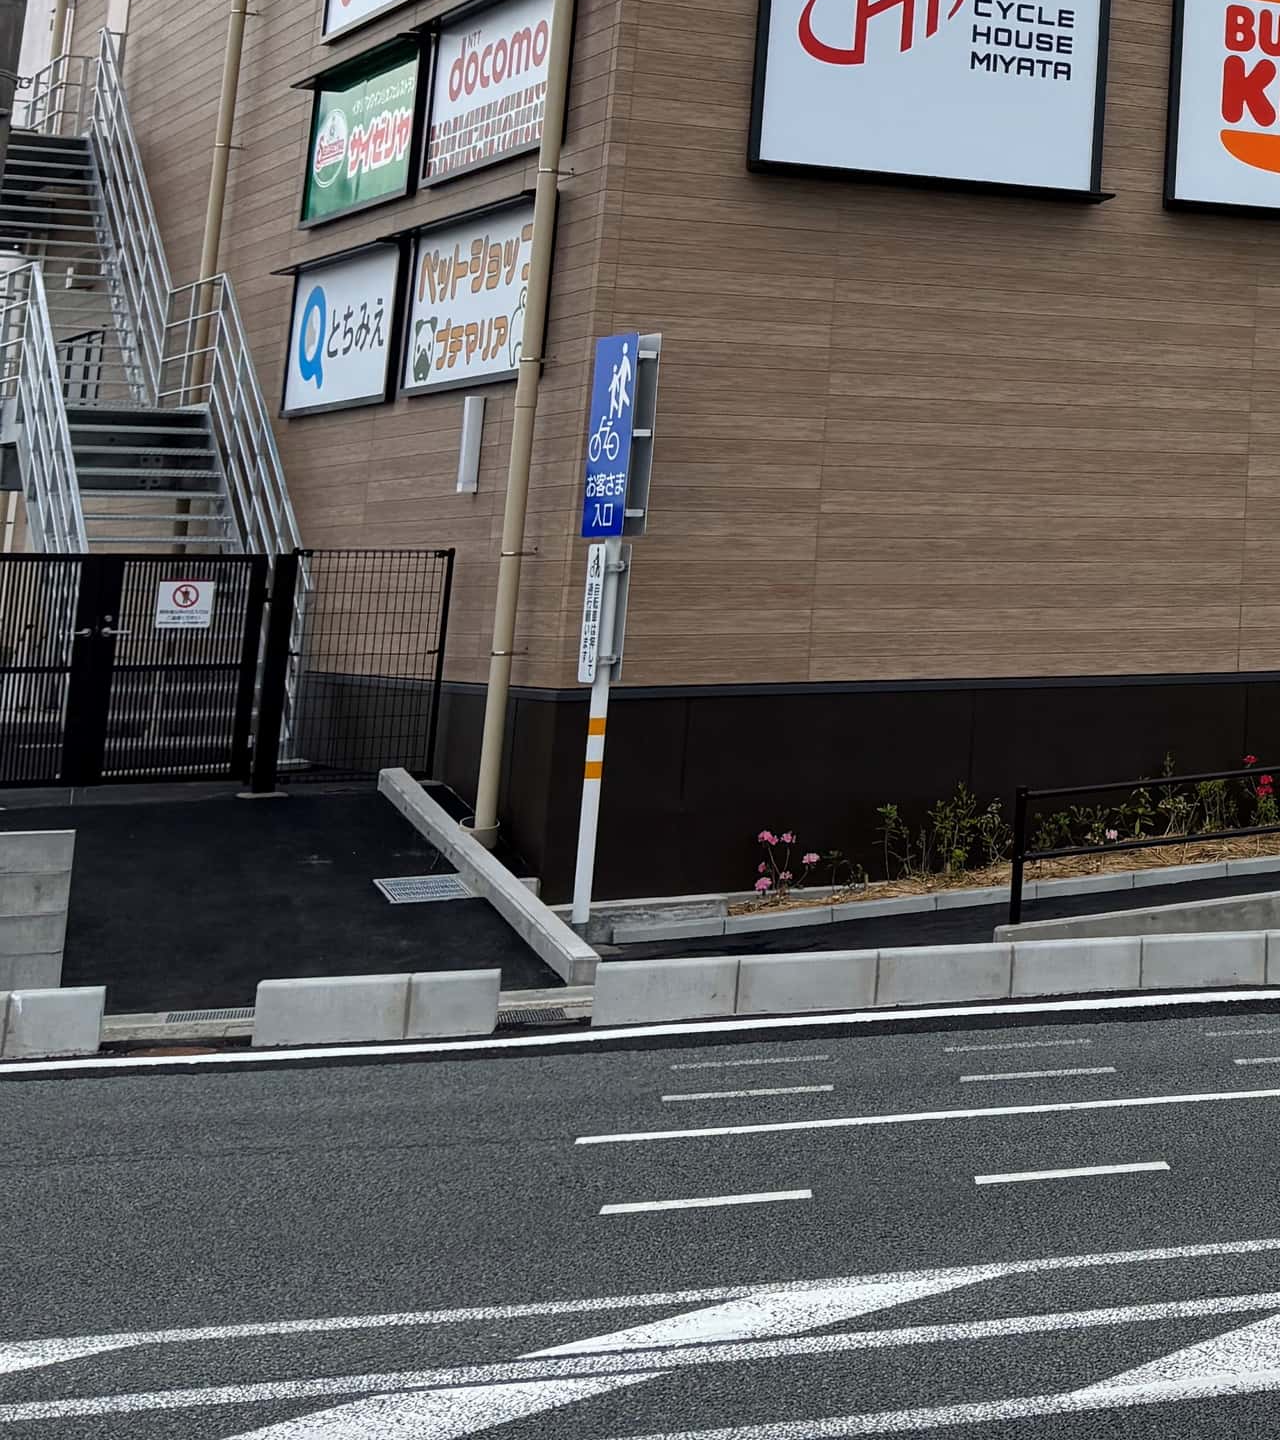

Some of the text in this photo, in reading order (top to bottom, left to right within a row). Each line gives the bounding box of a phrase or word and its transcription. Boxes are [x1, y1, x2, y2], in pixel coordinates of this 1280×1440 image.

[467, 30, 482, 49] NTT
[972, 23, 1074, 56] HOUSE
[448, 19, 549, 102] docomo
[970, 50, 1073, 82] MIYATA
[327, 297, 384, 358] とちみえ
[436, 315, 508, 370] プチマリア
[586, 471, 626, 497] お客さま
[592, 503, 614, 528] 入口
